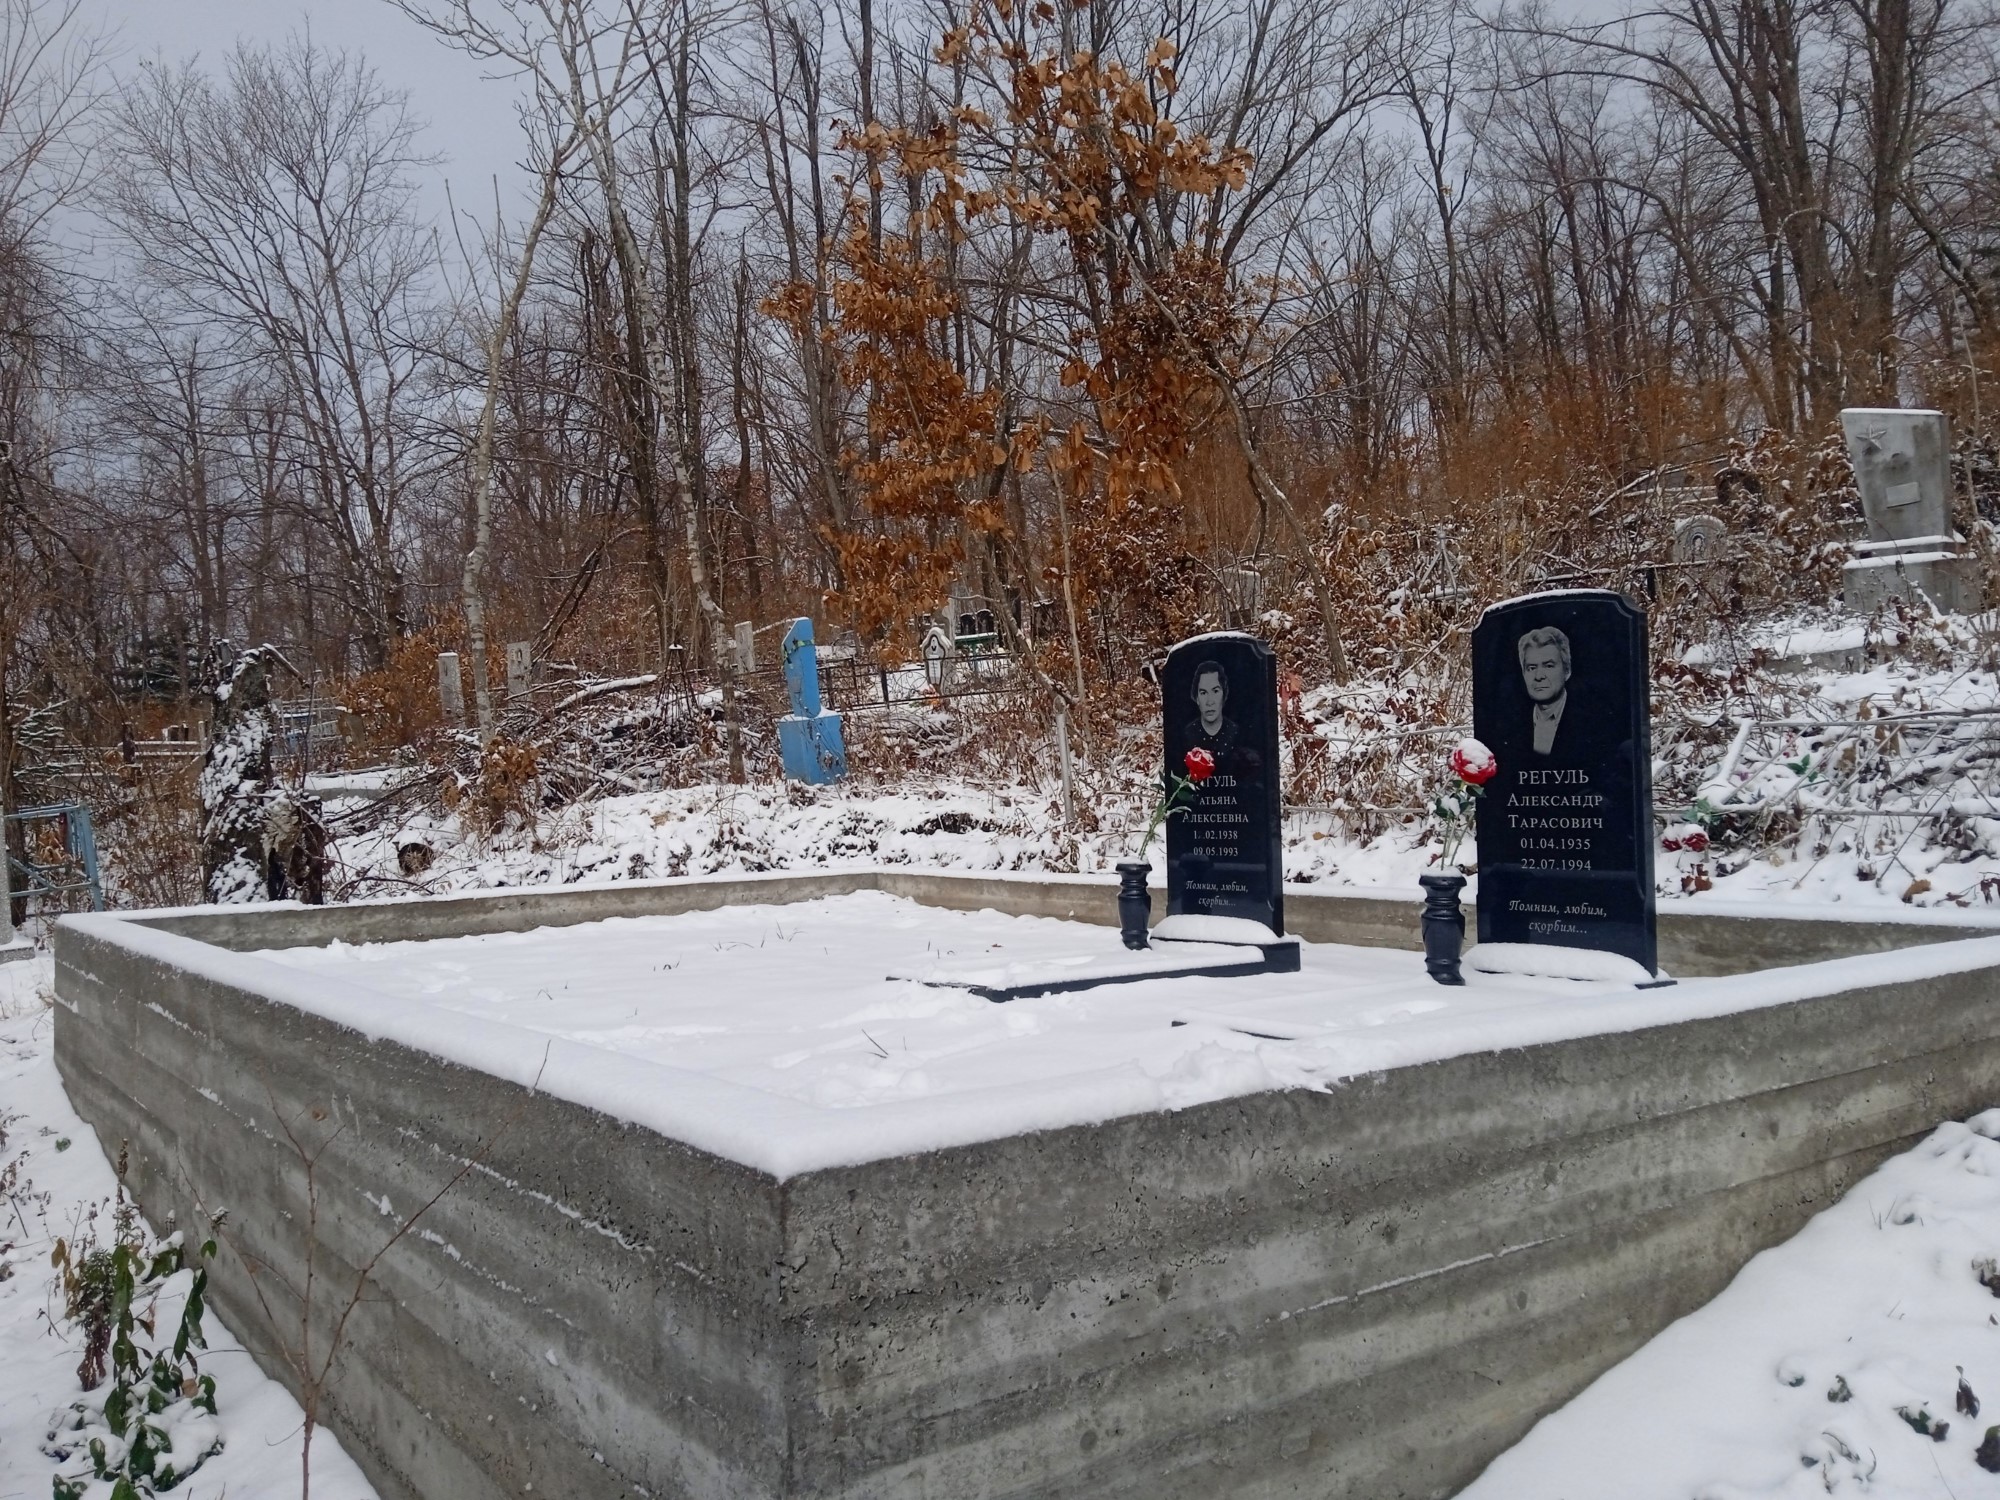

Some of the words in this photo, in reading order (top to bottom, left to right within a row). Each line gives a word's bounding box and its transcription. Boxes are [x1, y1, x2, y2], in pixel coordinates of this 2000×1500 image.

[1197, 776, 1237, 787] ГУЛЬ
[1518, 769, 1589, 785] РЕГУЛЬ
[1192, 795, 1237, 805] АТЬЯНА
[1194, 830, 1238, 839] 1.02.1938
[1520, 838, 1591, 850] 01.04.1935
[1193, 847, 1238, 856] 09.05.1993
[1521, 859, 1592, 871] 22.07.1994
[1185, 880, 1218, 891] Помним,
[1221, 882, 1248, 893] любим,
[1509, 900, 1560, 915] Помним,
[1564, 903, 1607, 918] любим,
[1528, 920, 1588, 935] скорбим...
